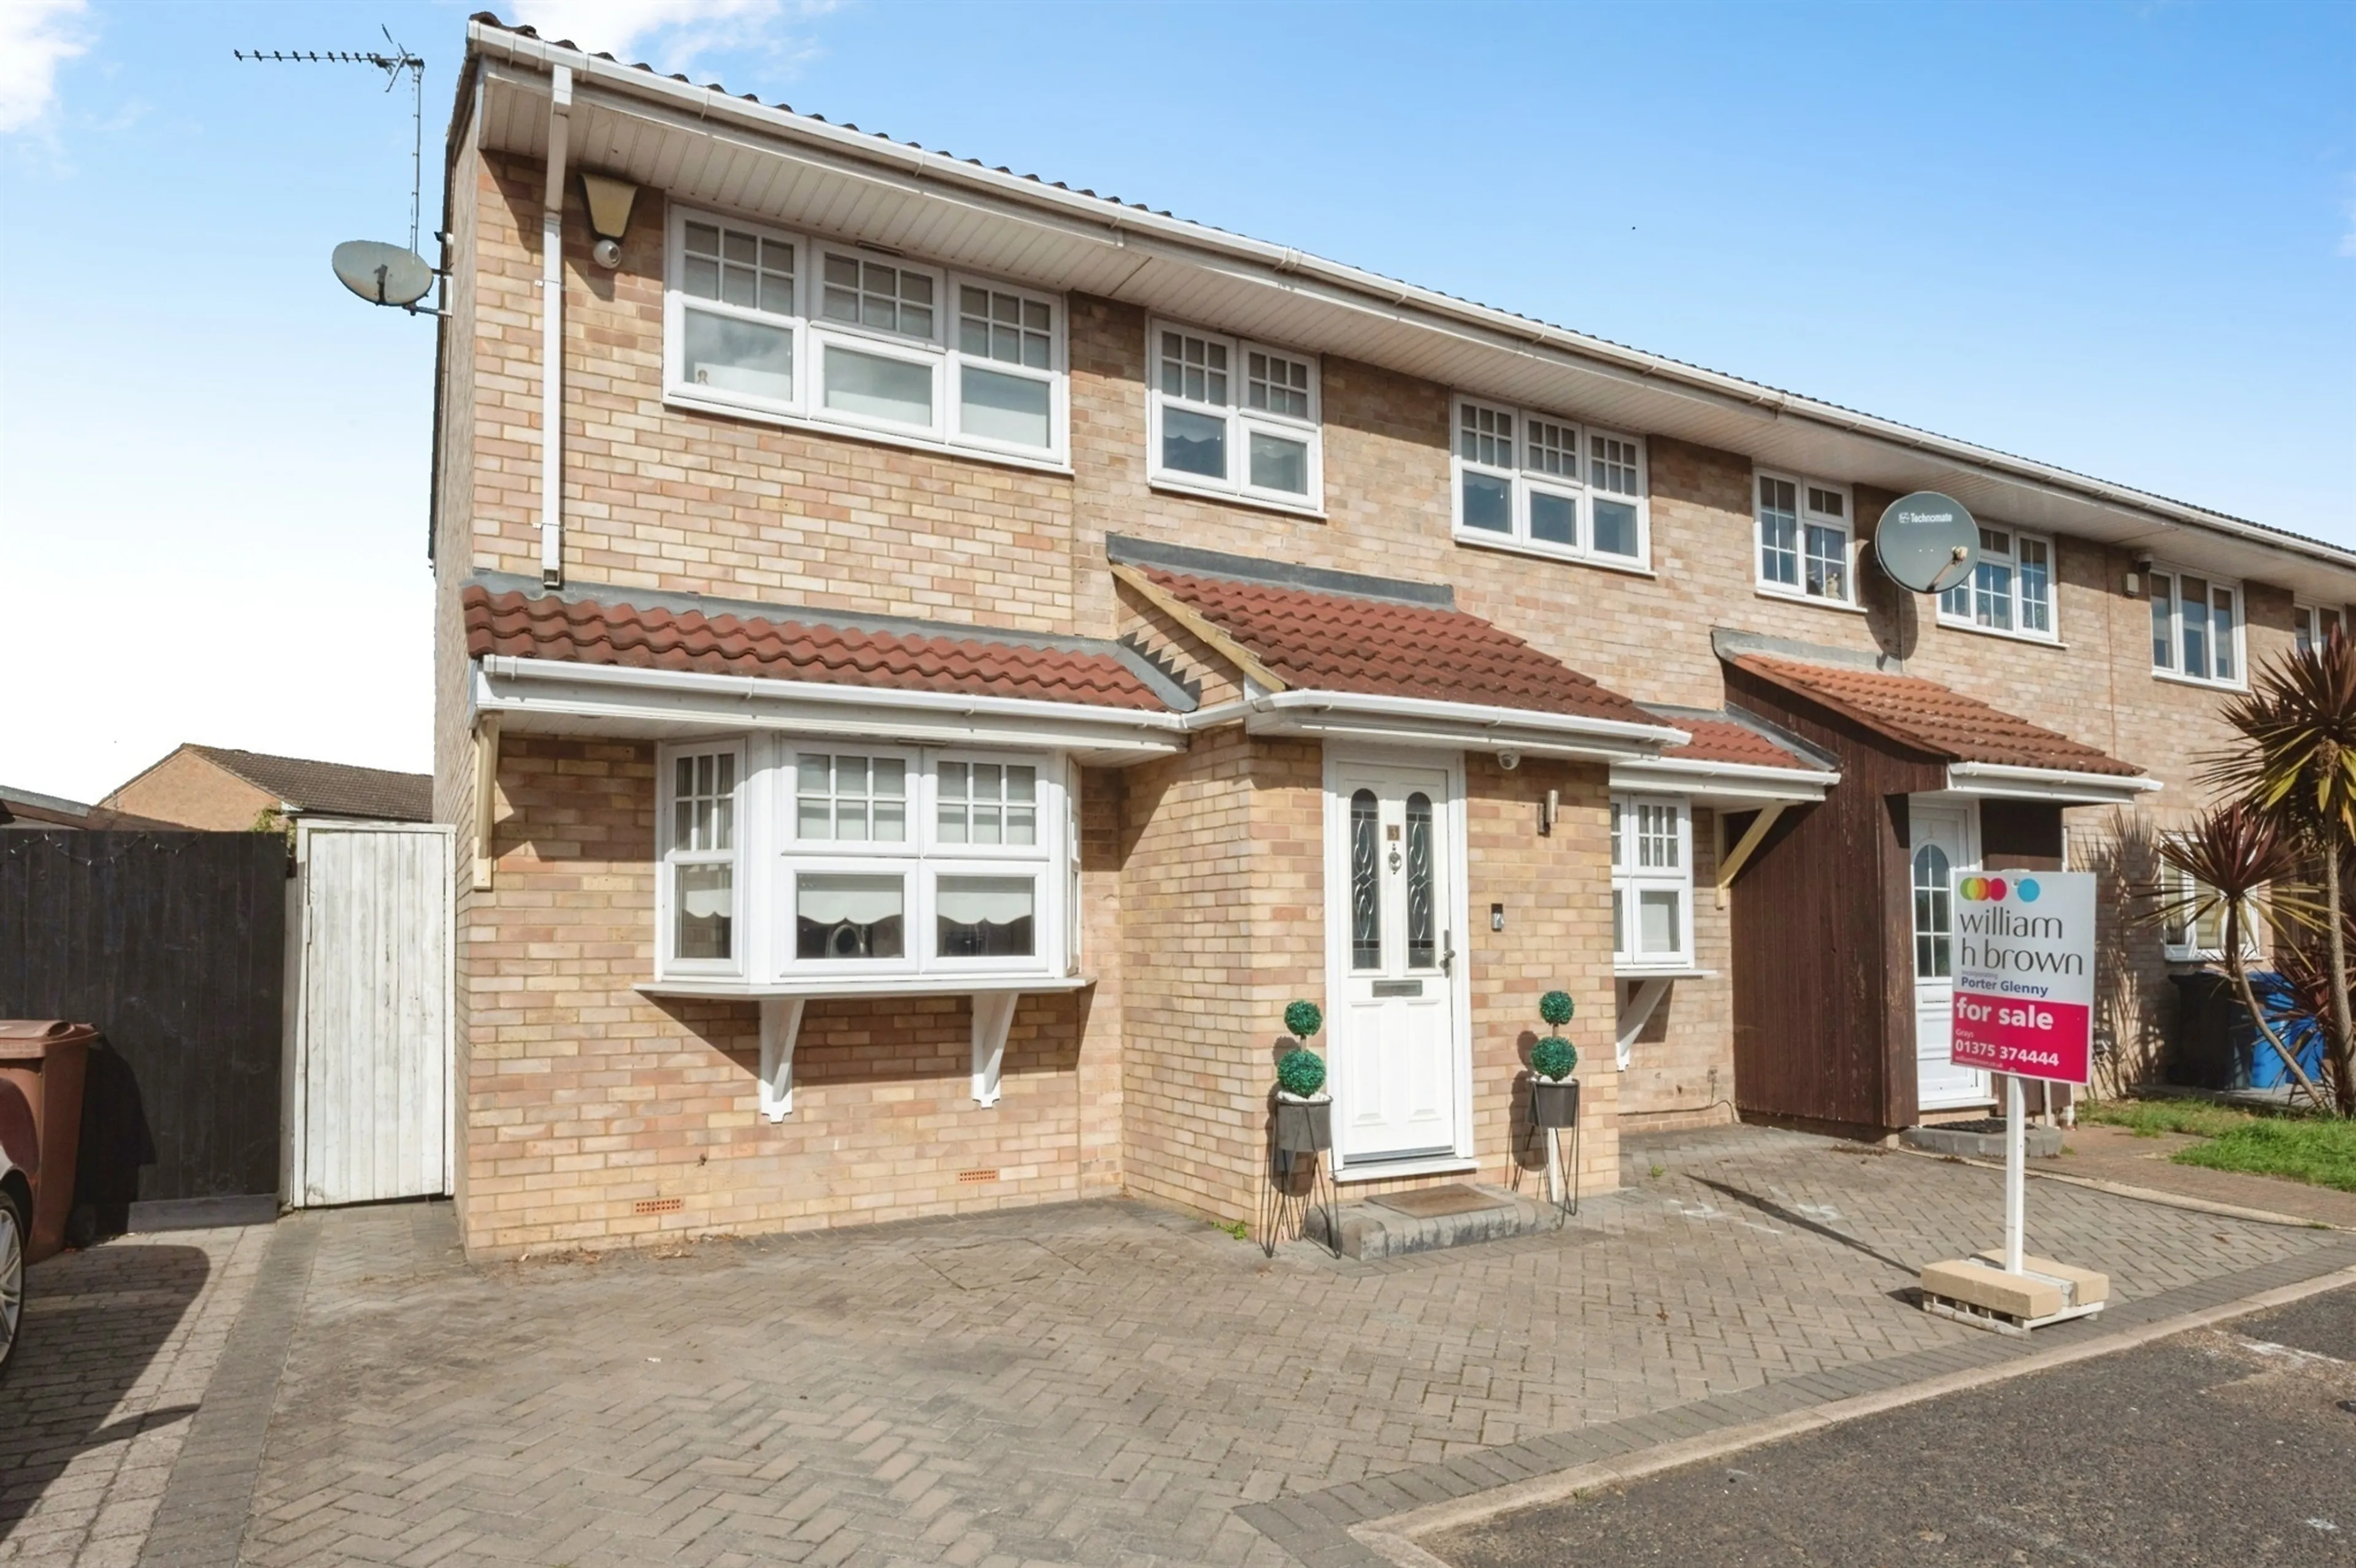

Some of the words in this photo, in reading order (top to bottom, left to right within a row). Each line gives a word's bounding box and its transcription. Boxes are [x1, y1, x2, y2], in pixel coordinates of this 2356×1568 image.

[1910, 512, 1952, 523] Technomate
[1960, 906, 2062, 939] william
[1961, 937, 1976, 967] h
[1984, 939, 2083, 975] brown
[1961, 976, 1997, 990] Porter
[2000, 980, 2049, 997] Glenny
[1956, 997, 1992, 1023] for
[1998, 1004, 2054, 1031] sale
[1955, 1028, 1974, 1039] Grays
[1955, 1039, 1996, 1057] 01375
[1999, 1046, 2060, 1067] 374444
